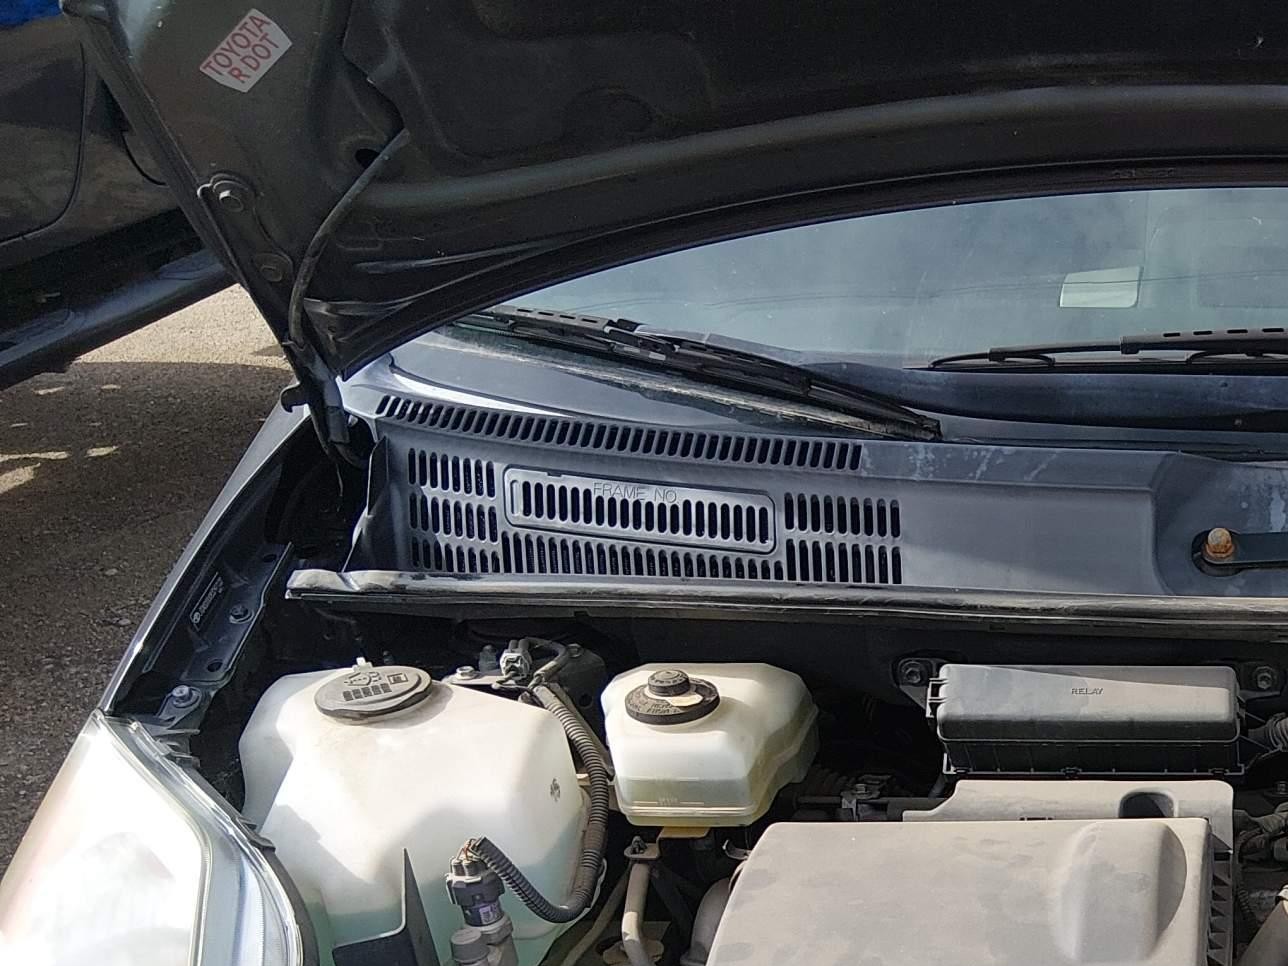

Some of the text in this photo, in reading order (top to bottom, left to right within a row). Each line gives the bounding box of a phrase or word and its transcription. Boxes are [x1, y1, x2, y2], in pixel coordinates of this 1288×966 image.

[203, 15, 272, 76] TOYOTA
[227, 32, 279, 84] R DOT
[593, 482, 648, 501] FRAME
[1071, 687, 1104, 696] RELAY
